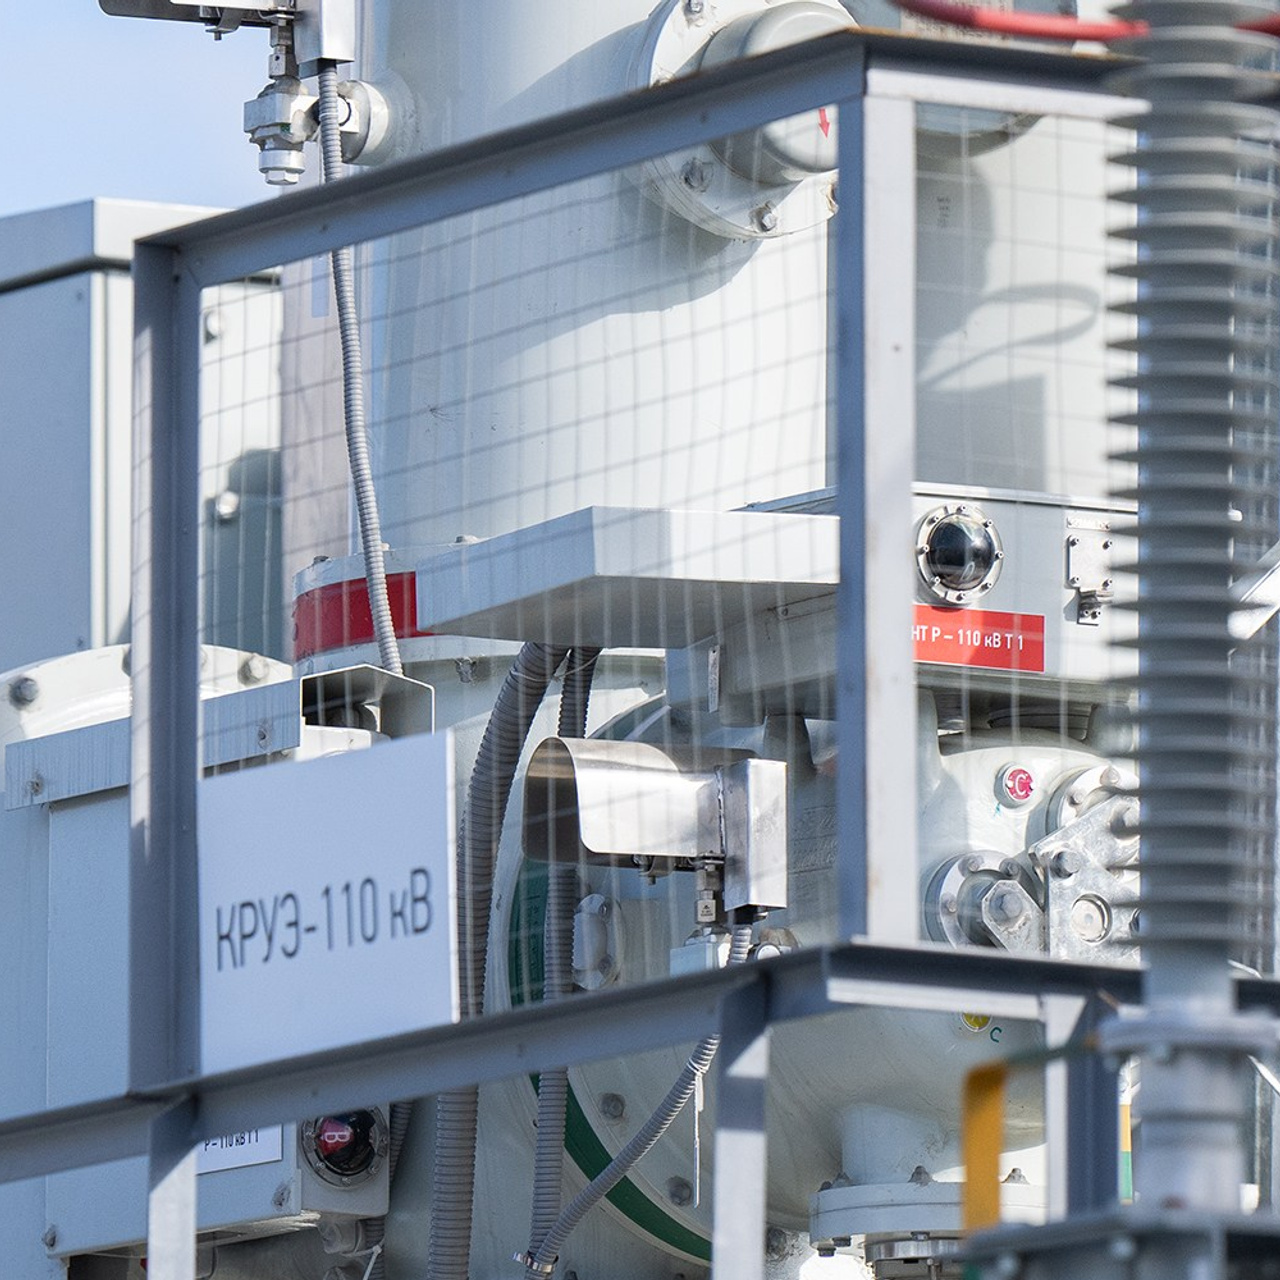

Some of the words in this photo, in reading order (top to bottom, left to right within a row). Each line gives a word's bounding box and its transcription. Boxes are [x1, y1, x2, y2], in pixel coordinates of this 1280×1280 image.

[957, 629, 980, 645] 110
[984, 632, 1000, 648] кВ
[216, 876, 377, 972] КРУЭ-110
[389, 867, 432, 938] кВ
